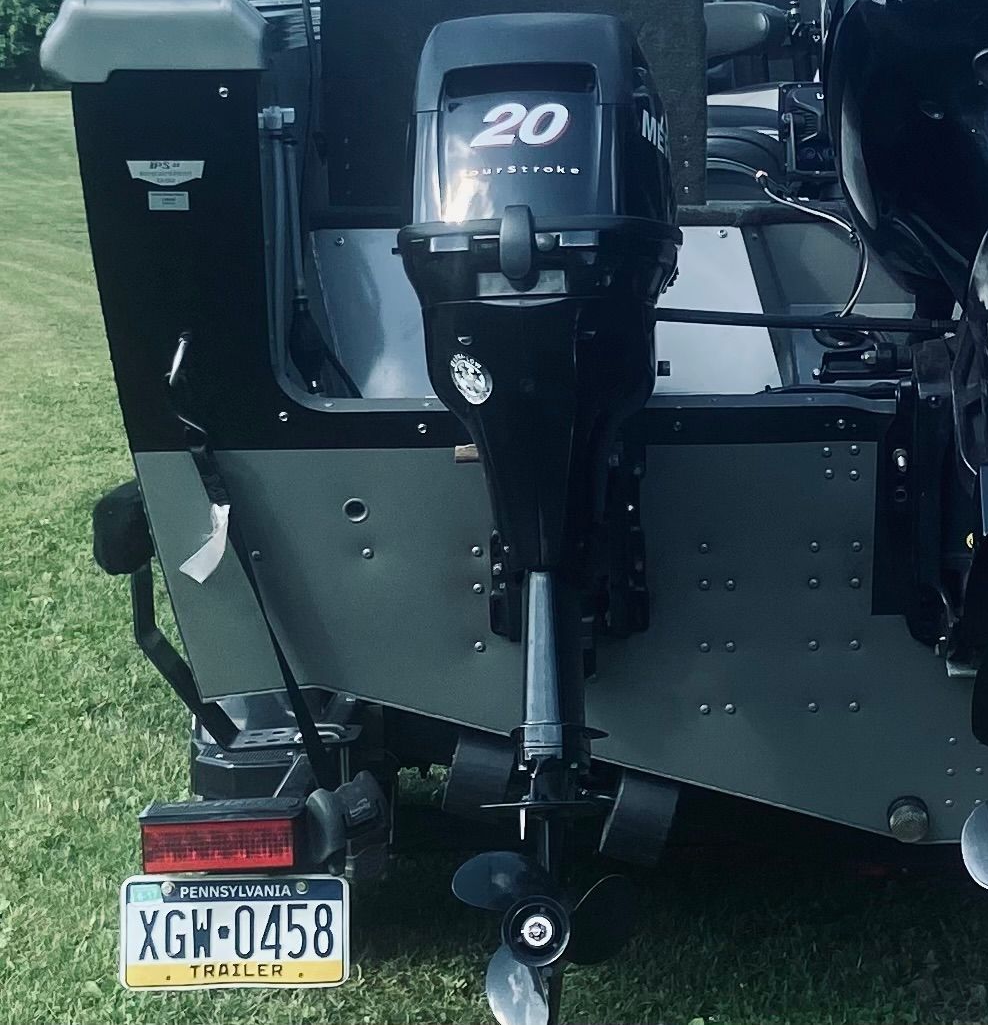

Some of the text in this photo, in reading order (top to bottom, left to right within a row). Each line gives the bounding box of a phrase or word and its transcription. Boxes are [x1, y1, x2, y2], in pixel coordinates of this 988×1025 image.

[470, 103, 571, 148] 20
[462, 164, 580, 177] ourStroke
[180, 884, 292, 899] PENNSYLVANIA
[190, 963, 283, 979] TRAILER
